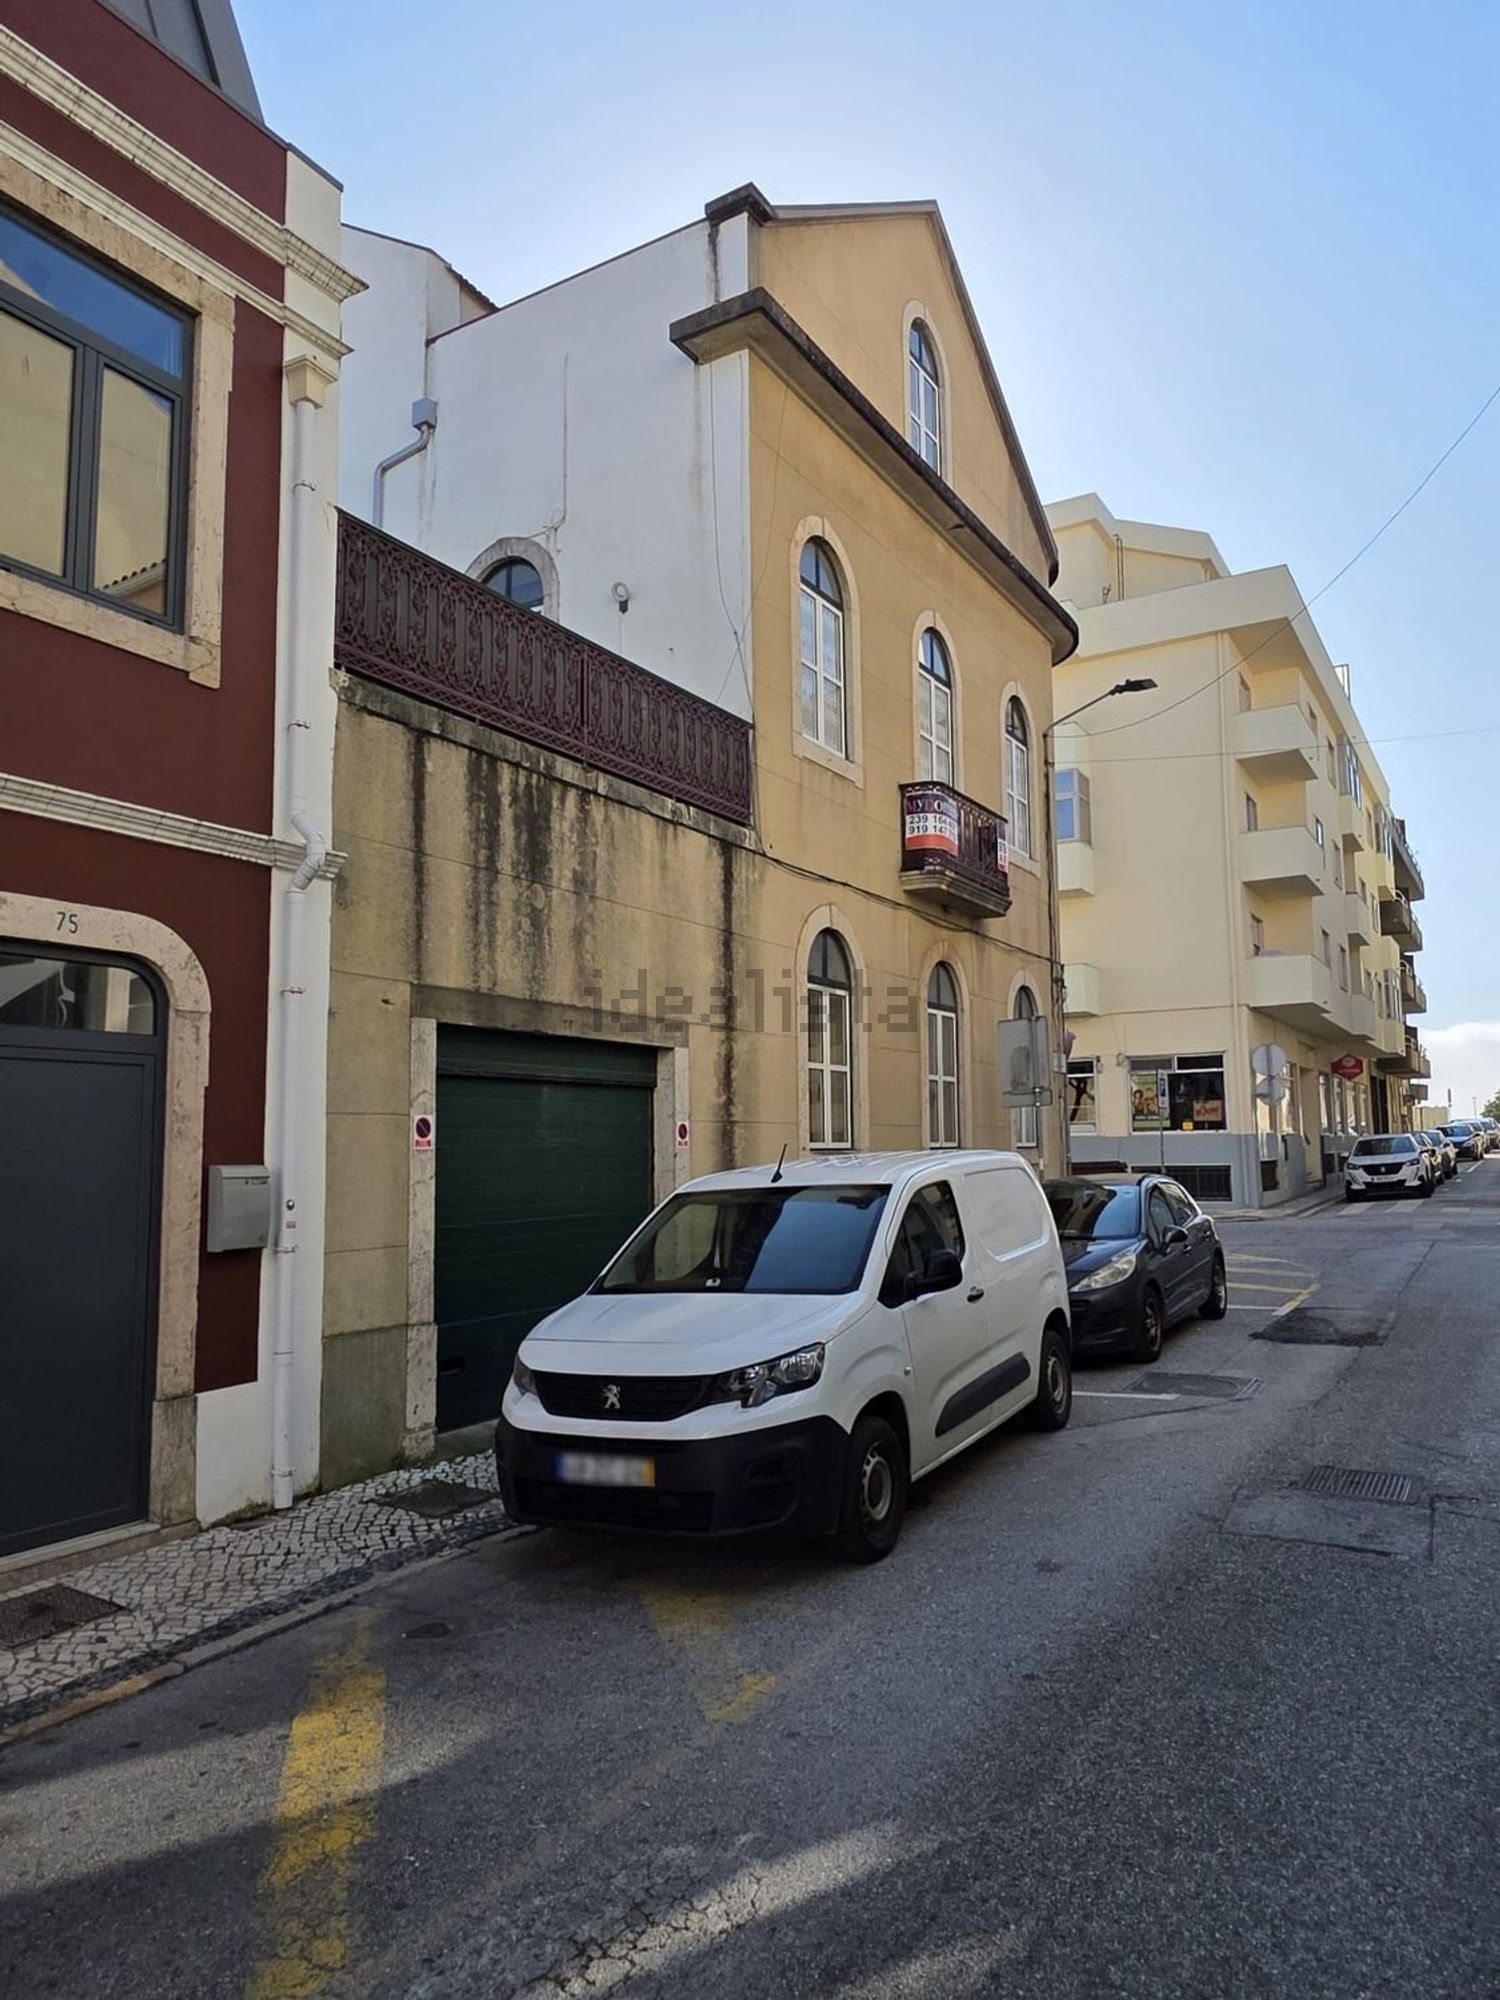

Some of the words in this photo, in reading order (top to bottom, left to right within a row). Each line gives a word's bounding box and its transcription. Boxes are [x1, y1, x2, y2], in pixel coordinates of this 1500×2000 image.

[909, 815, 928, 824] 239
[909, 825, 928, 834] 919
[56, 911, 79, 934] 75
